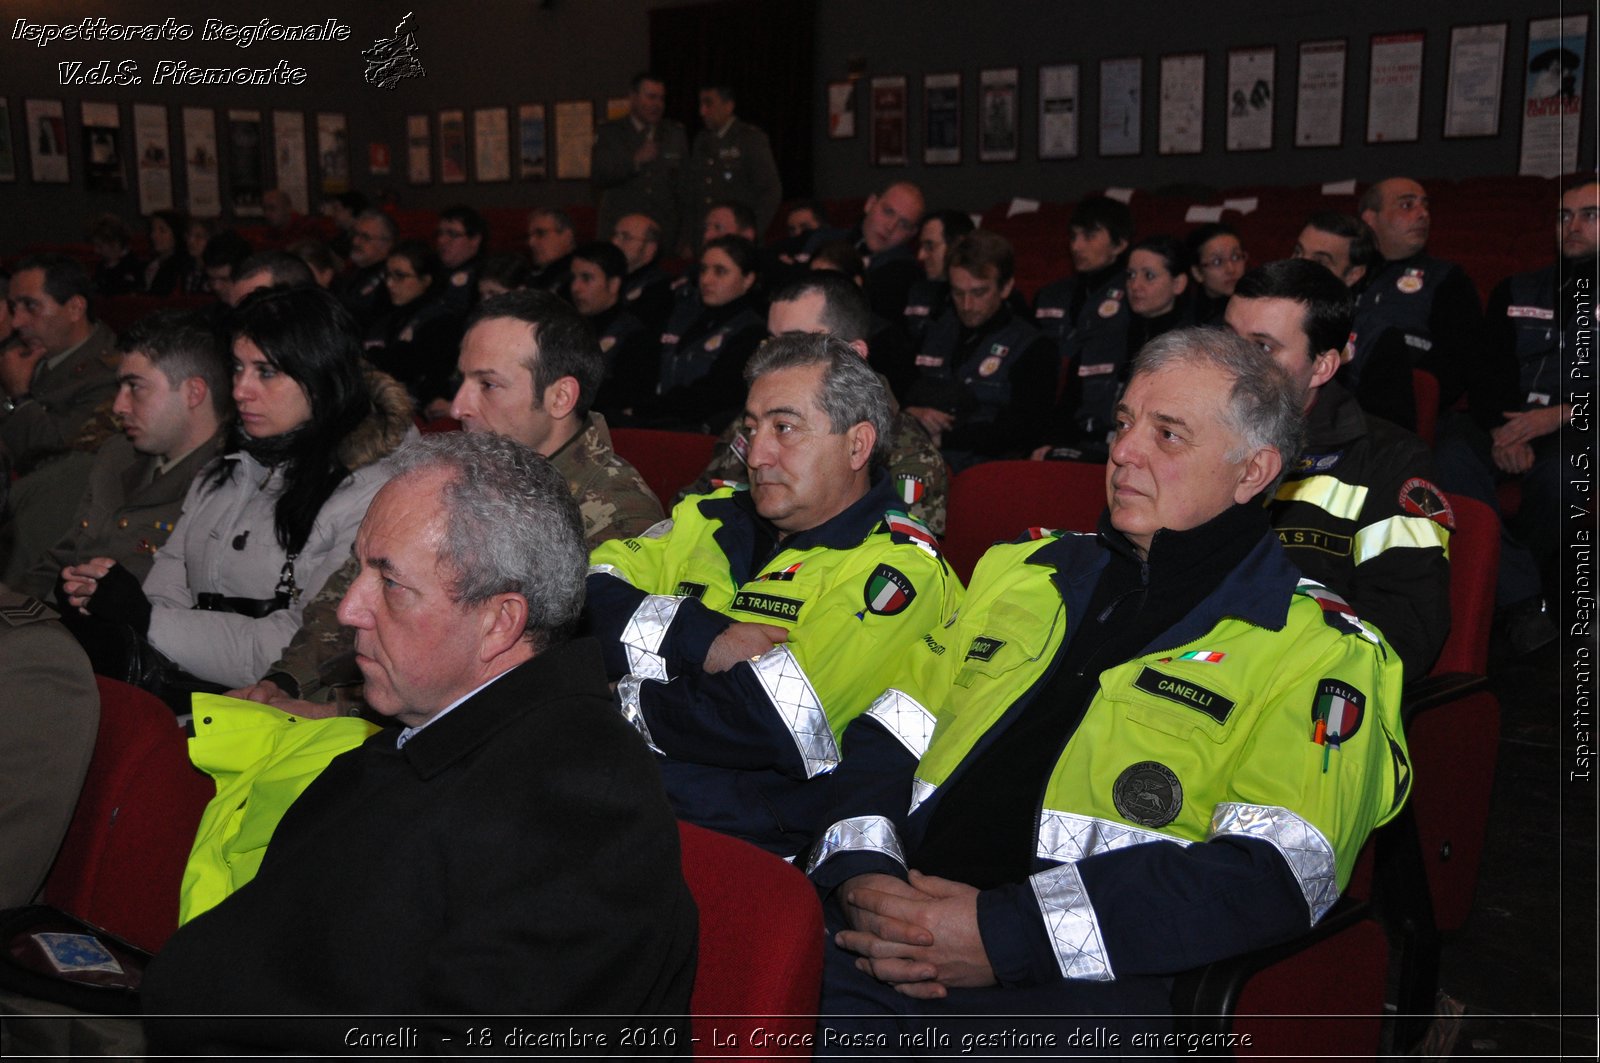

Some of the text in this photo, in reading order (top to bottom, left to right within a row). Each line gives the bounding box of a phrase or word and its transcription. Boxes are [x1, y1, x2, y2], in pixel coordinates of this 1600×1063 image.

[624, 538, 642, 553] ASTI
[1279, 531, 1328, 548] ASTI
[883, 570, 910, 595] ITALIA
[736, 596, 746, 606] G.
[1158, 680, 1214, 707] CANELLI
[1325, 686, 1358, 704] ITALIA
